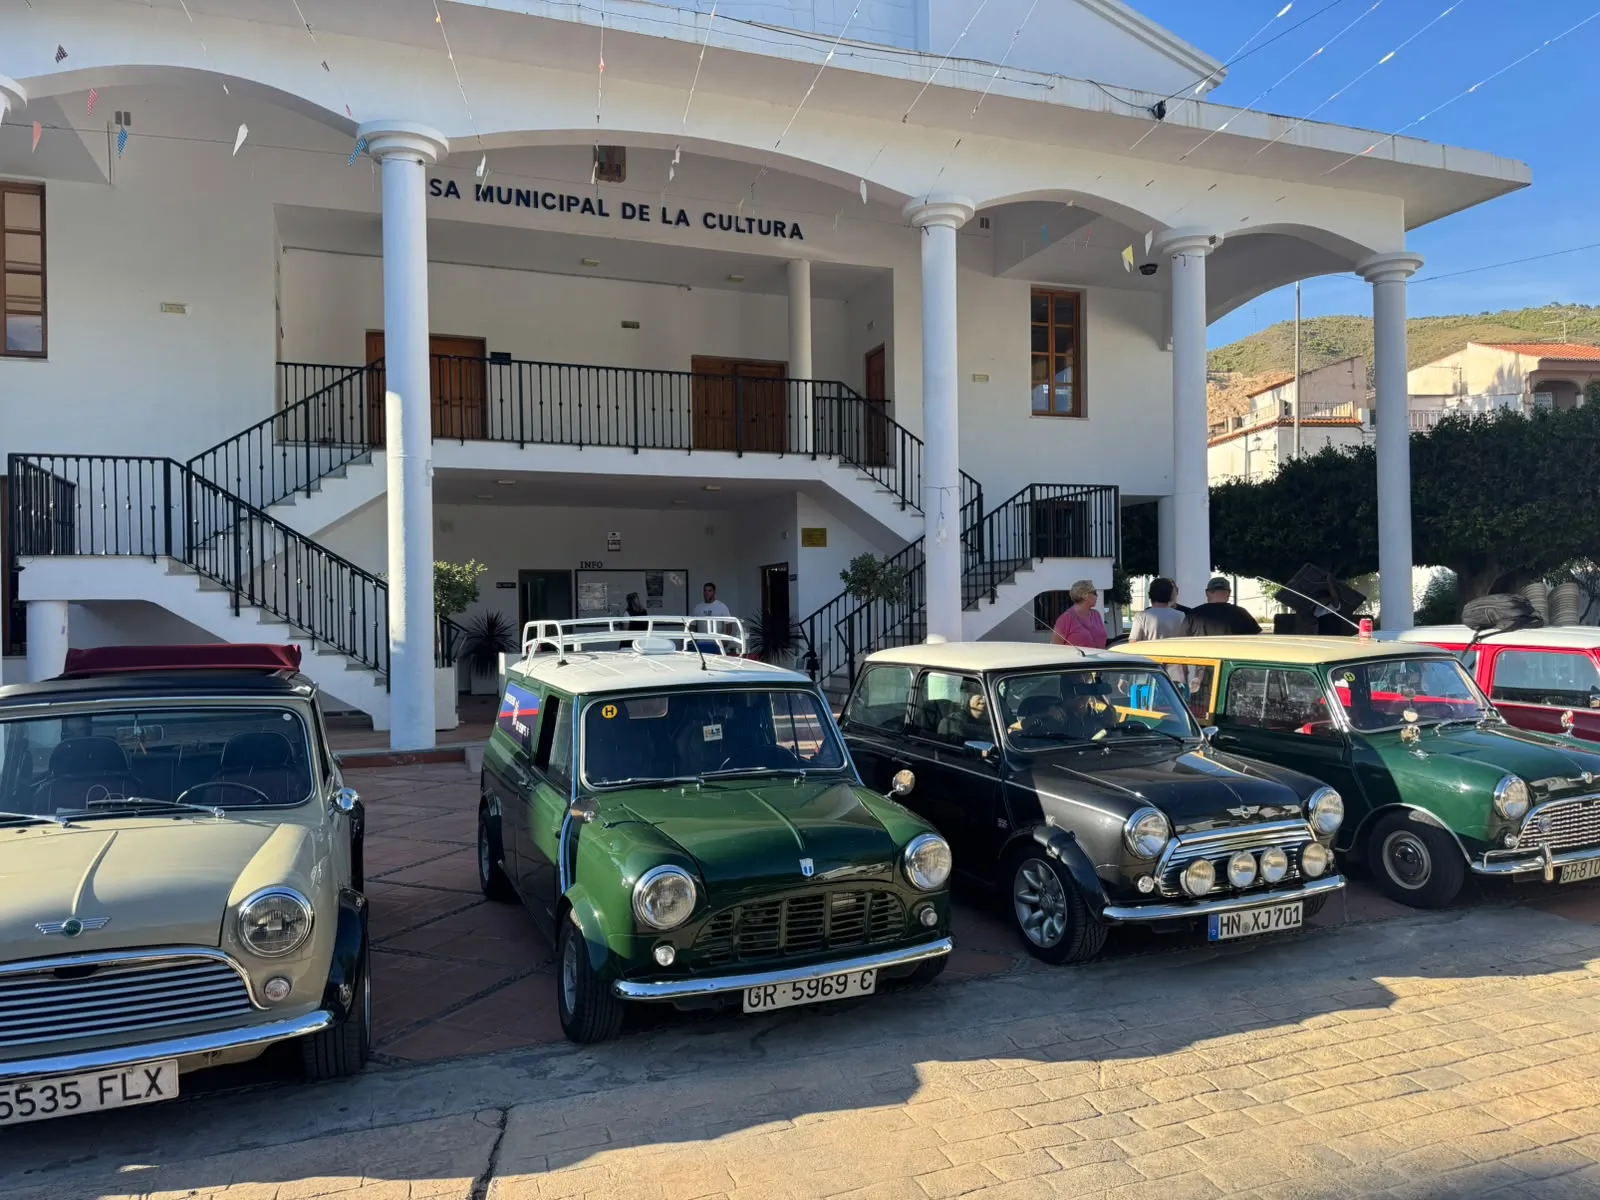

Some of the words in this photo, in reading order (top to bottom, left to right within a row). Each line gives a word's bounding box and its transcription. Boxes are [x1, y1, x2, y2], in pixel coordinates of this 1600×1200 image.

[429, 178, 461, 199] SA
[475, 184, 610, 217] MUNICIPAL
[621, 202, 651, 222] DE
[661, 206, 690, 227] LA
[702, 212, 804, 241] CULTURA
[1220, 914, 1240, 936] HN
[0, 1080, 82, 1120] 5535
[98, 1067, 163, 1105] FLX
